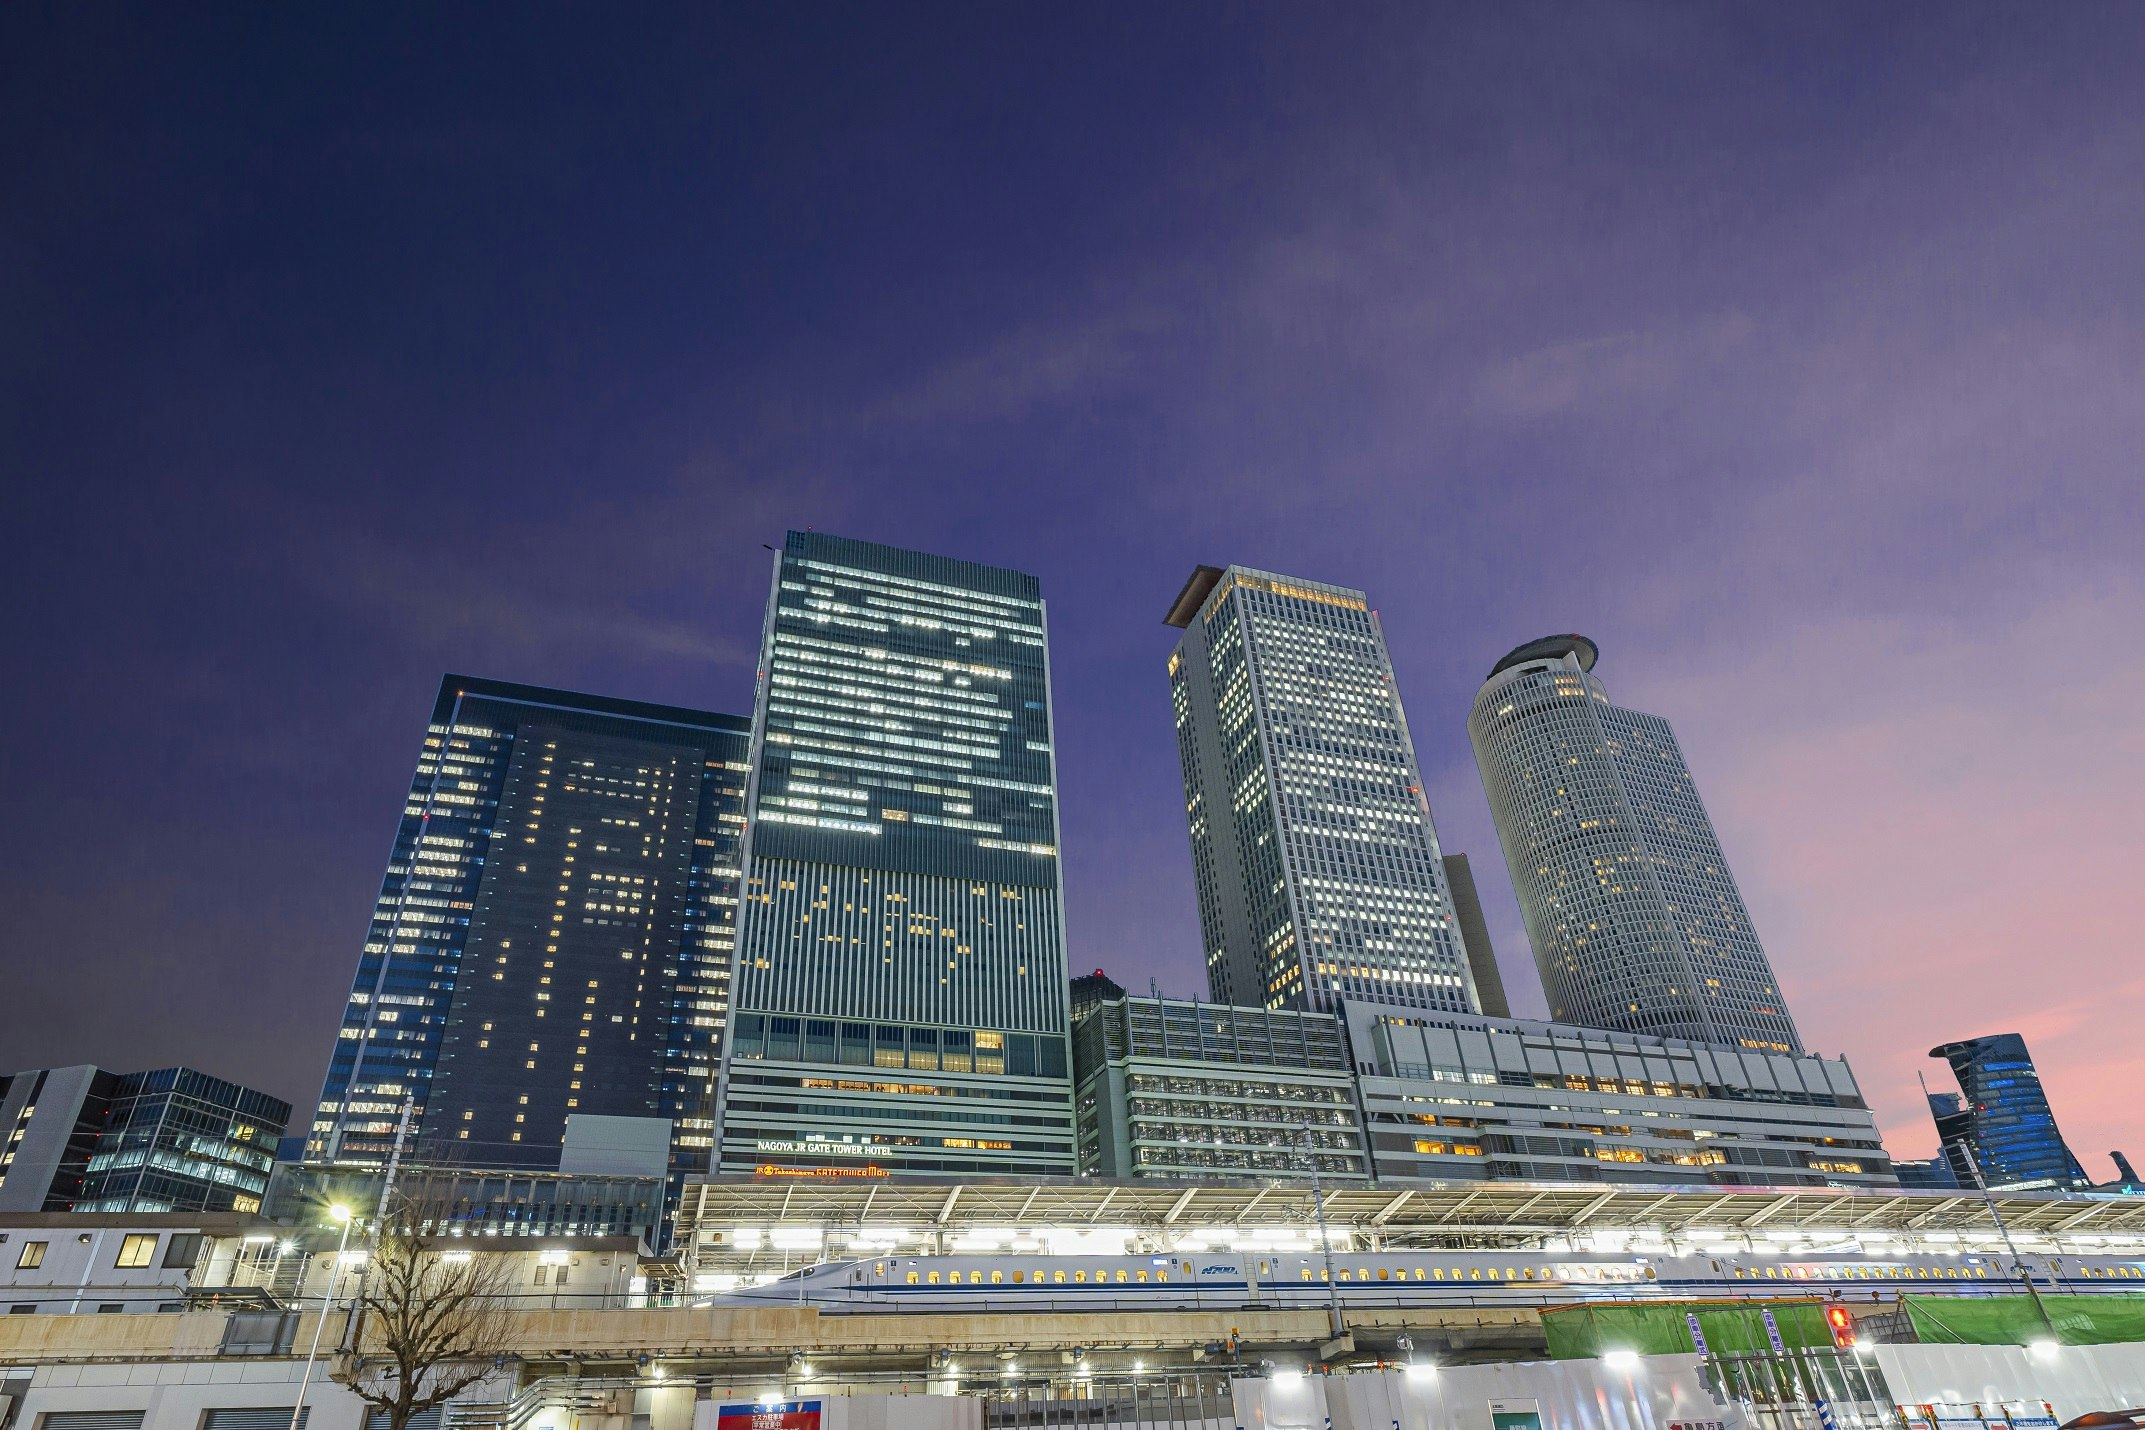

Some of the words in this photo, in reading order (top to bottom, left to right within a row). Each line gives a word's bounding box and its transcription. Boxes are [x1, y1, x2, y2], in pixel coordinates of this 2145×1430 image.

[757, 1141, 793, 1152] NAGOYA
[795, 1143, 805, 1152] JR
[808, 1143, 830, 1153] GATE
[832, 1144, 862, 1155] TOWER
[865, 1145, 892, 1156] HOTEL
